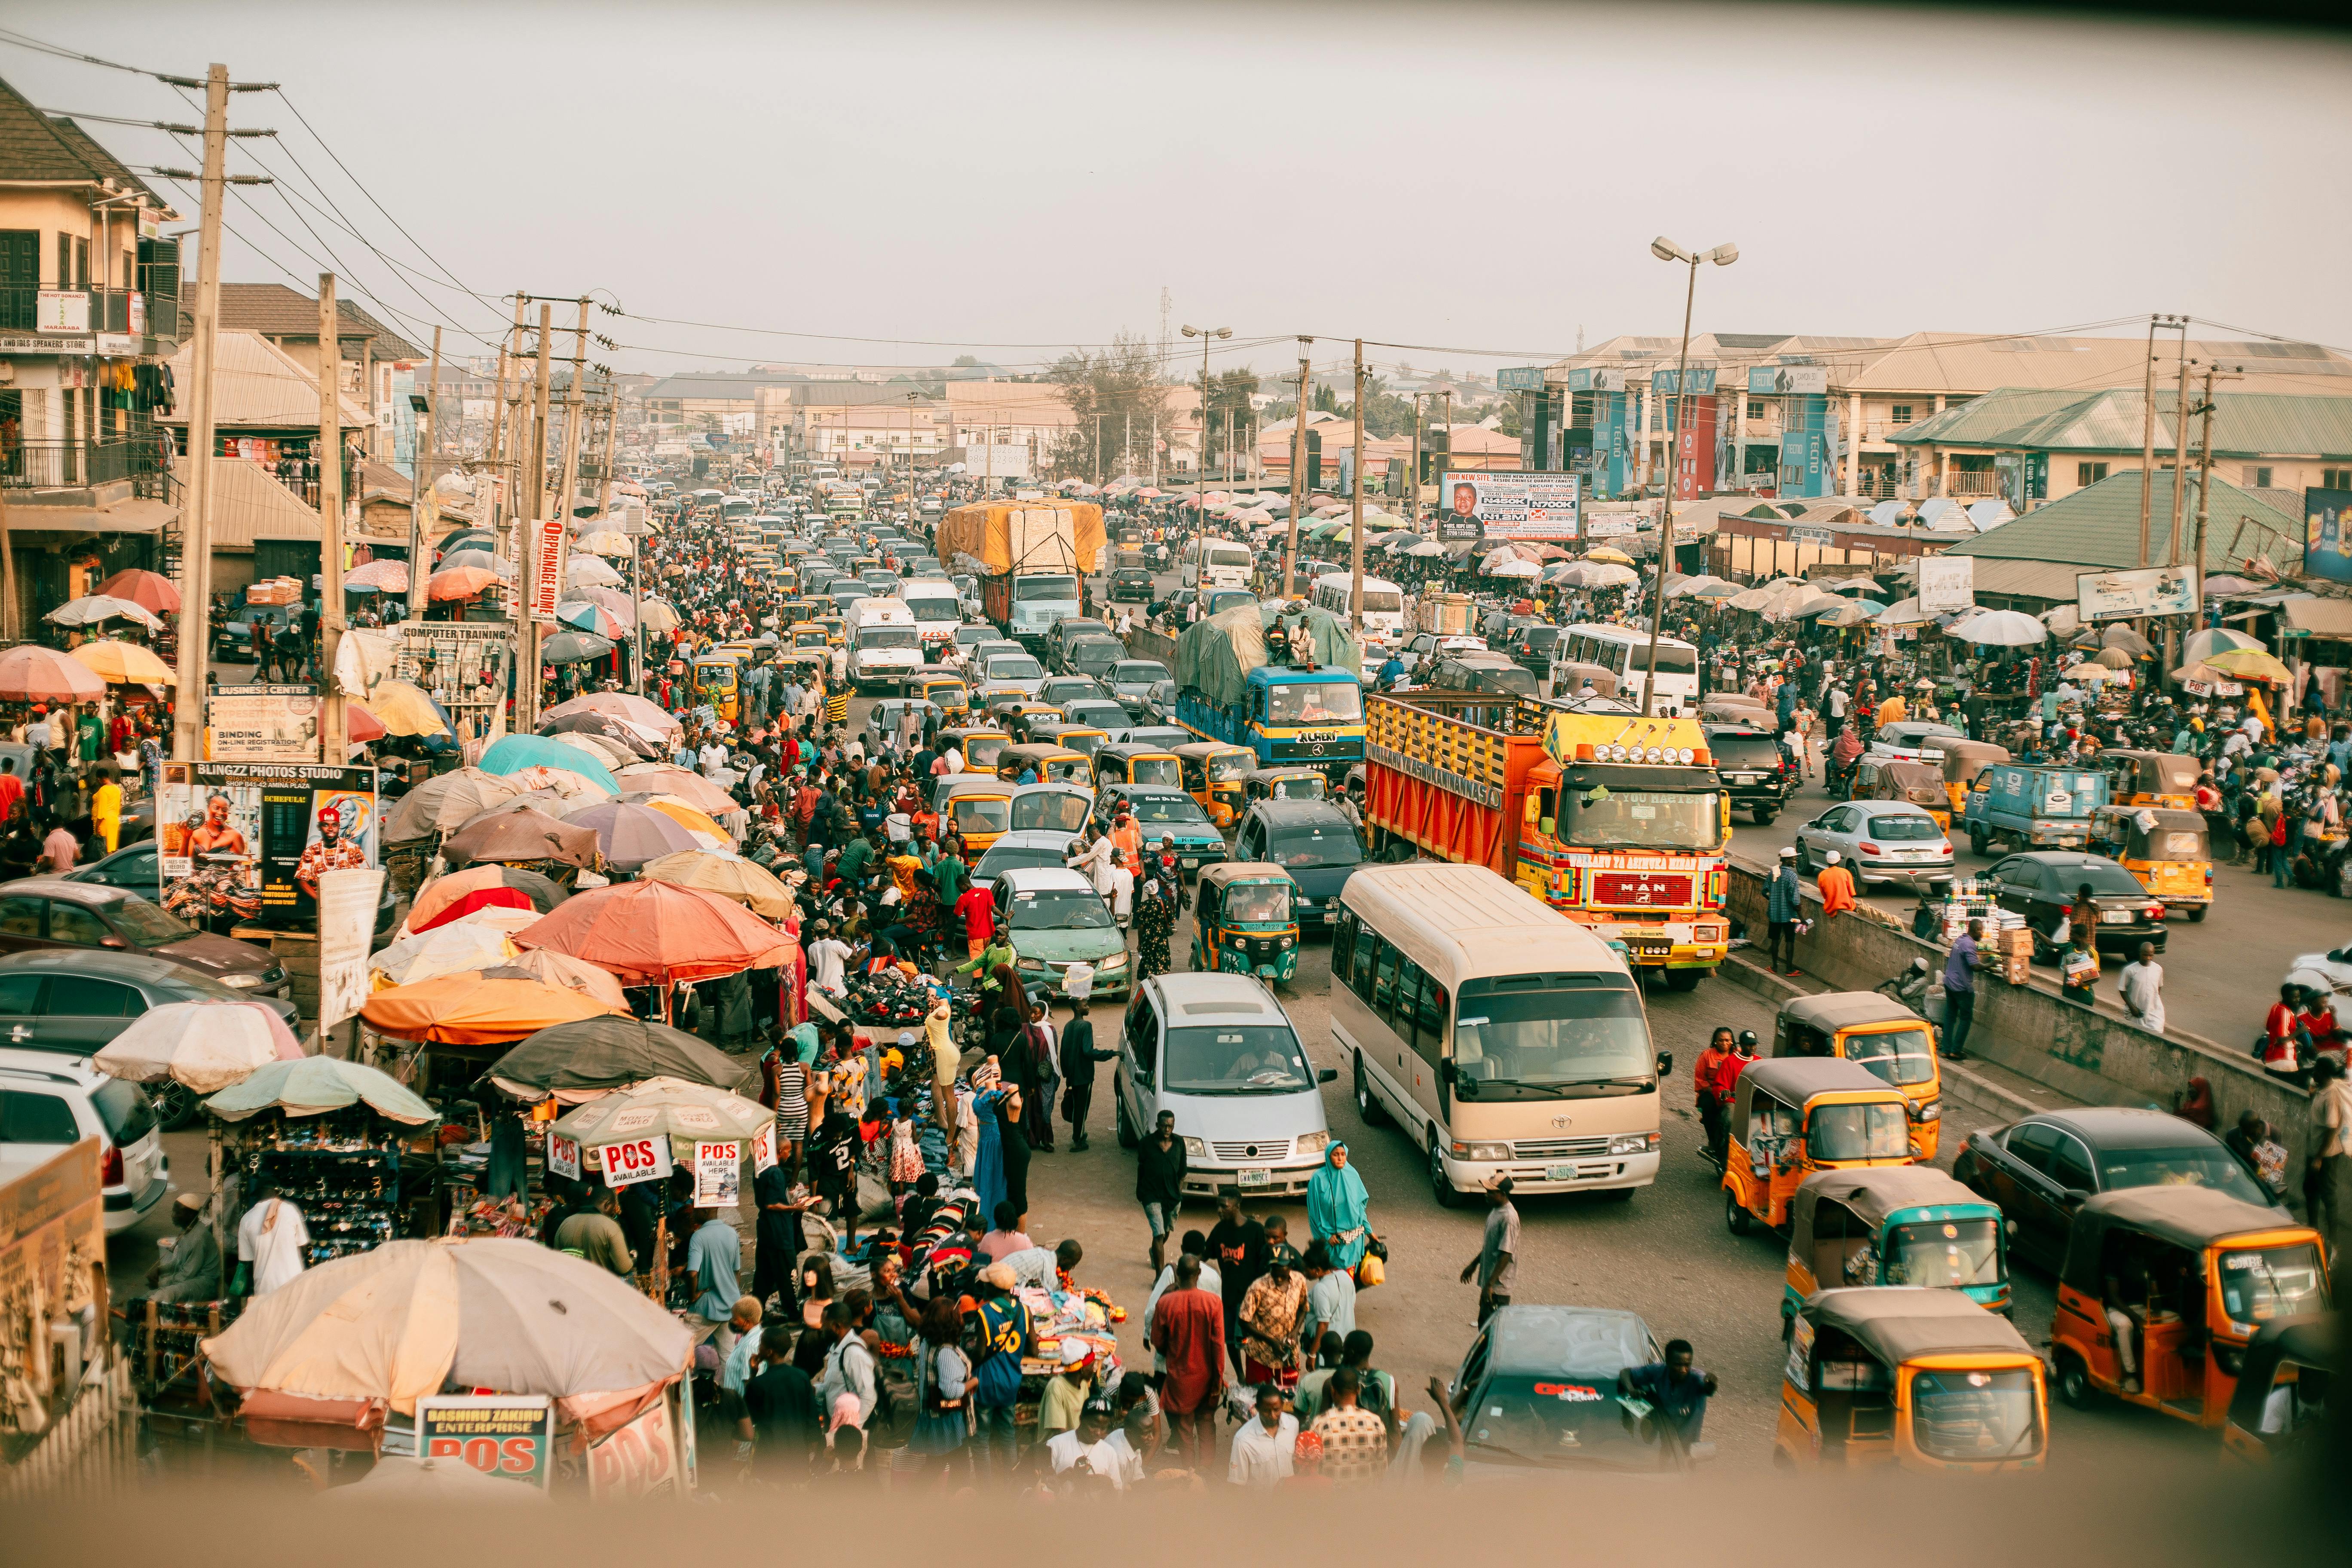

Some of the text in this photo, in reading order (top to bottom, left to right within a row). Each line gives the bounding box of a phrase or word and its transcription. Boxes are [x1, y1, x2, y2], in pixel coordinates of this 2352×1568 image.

[33, 340, 63, 348] SPEAKERS
[1515, 373, 1528, 383] TECNO
[1571, 374, 1586, 386] TECNO
[1753, 373, 1773, 387] TECNO
[1596, 432, 1608, 441] TECNO
[1614, 424, 1622, 457] TECNO
[1786, 444, 1803, 454] TECNO
[1810, 433, 1820, 473] TECNO
[2327, 506, 2335, 521] The
[1811, 529, 1822, 537] TRANSIT
[2326, 522, 2335, 536] Rich
[2322, 538, 2338, 552] Custard
[539, 522, 563, 614] ORPHANAGE HOME
[1767, 610, 1777, 619] POS
[403, 628, 506, 640] COMPUTER TRAINING
[218, 686, 309, 695] BUSINESS CENTER
[2188, 680, 2206, 693] POS
[216, 699, 283, 707] PHOTOCOPY
[291, 701, 312, 710] B26
[216, 709, 286, 718] TYPESETTING
[217, 720, 286, 729] LAMINATION
[1298, 732, 1336, 743] ALHERI
[198, 764, 247, 776] BLINGZZ
[249, 765, 296, 778] PHOTOS
[1623, 793, 1646, 803] YOU
[1569, 855, 1611, 868] WALLAHU
[1613, 856, 1625, 869] YA
[1626, 856, 1667, 870] ASIMUKA
[1621, 884, 1665, 892] MAN
[577, 1117, 596, 1126] CARLO
[583, 1112, 600, 1122] MONTE
[618, 1118, 649, 1127] CARLO
[619, 1114, 653, 1122] MONTE
[552, 1134, 576, 1164] POS
[701, 1144, 736, 1160] POS
[606, 1140, 655, 1173] POS
[835, 1146, 850, 1170] 2
[553, 1165, 575, 1177] AVAILABLE
[612, 1167, 656, 1182] AVAILABLE
[708, 1167, 728, 1175] HERE
[427, 1409, 543, 1423] BASHIRU ZAKIRU
[436, 1422, 532, 1433] ENTERPRISE
[429, 1438, 535, 1472] POS
[594, 1409, 669, 1496] POS
